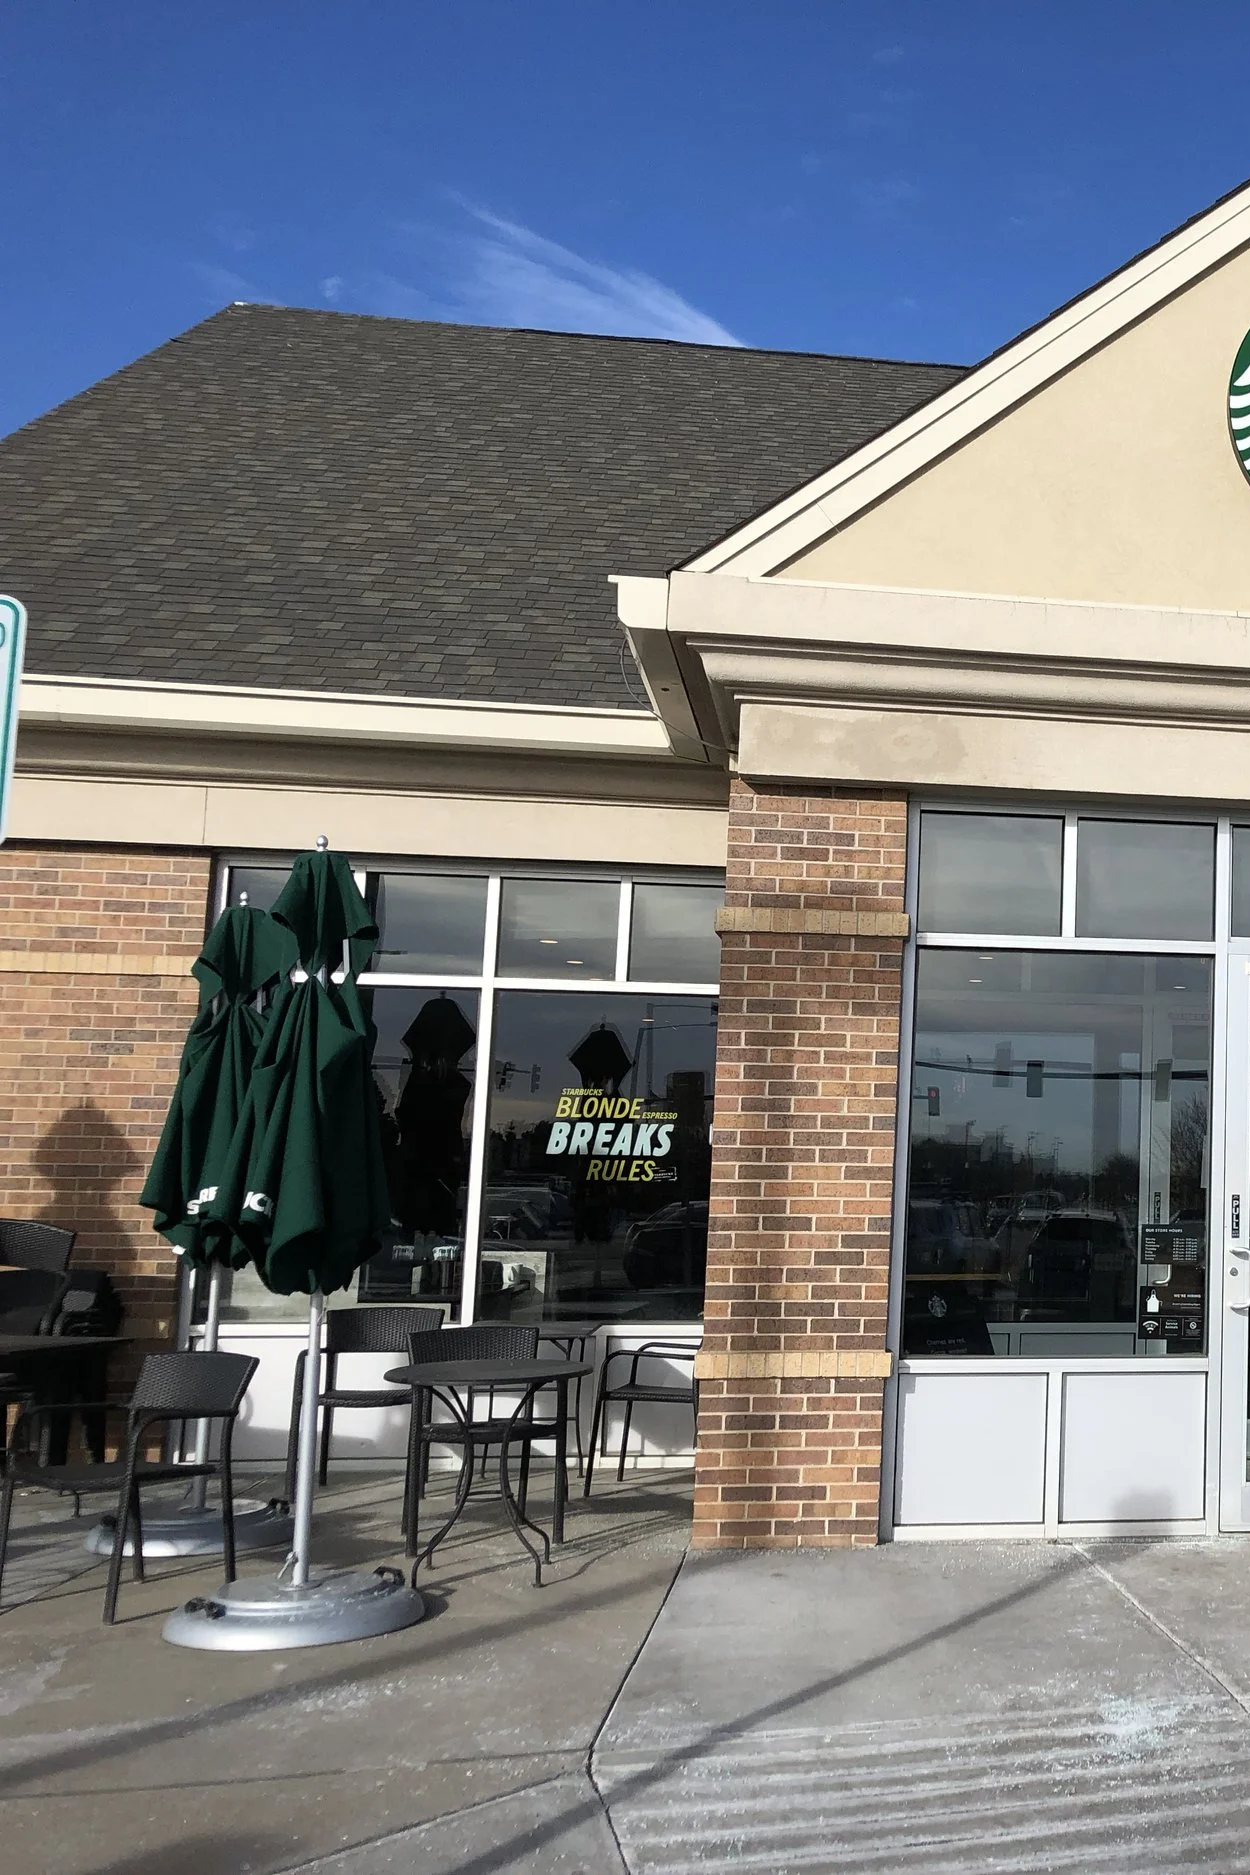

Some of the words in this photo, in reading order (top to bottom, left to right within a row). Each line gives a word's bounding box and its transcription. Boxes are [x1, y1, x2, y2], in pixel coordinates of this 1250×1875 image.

[555, 1097, 644, 1119] BLONDE
[642, 1111, 678, 1120] ESPRESSO
[546, 1121, 675, 1157] BREAKS
[586, 1160, 656, 1182] RULES
[1232, 1200, 1240, 1229] PULL
